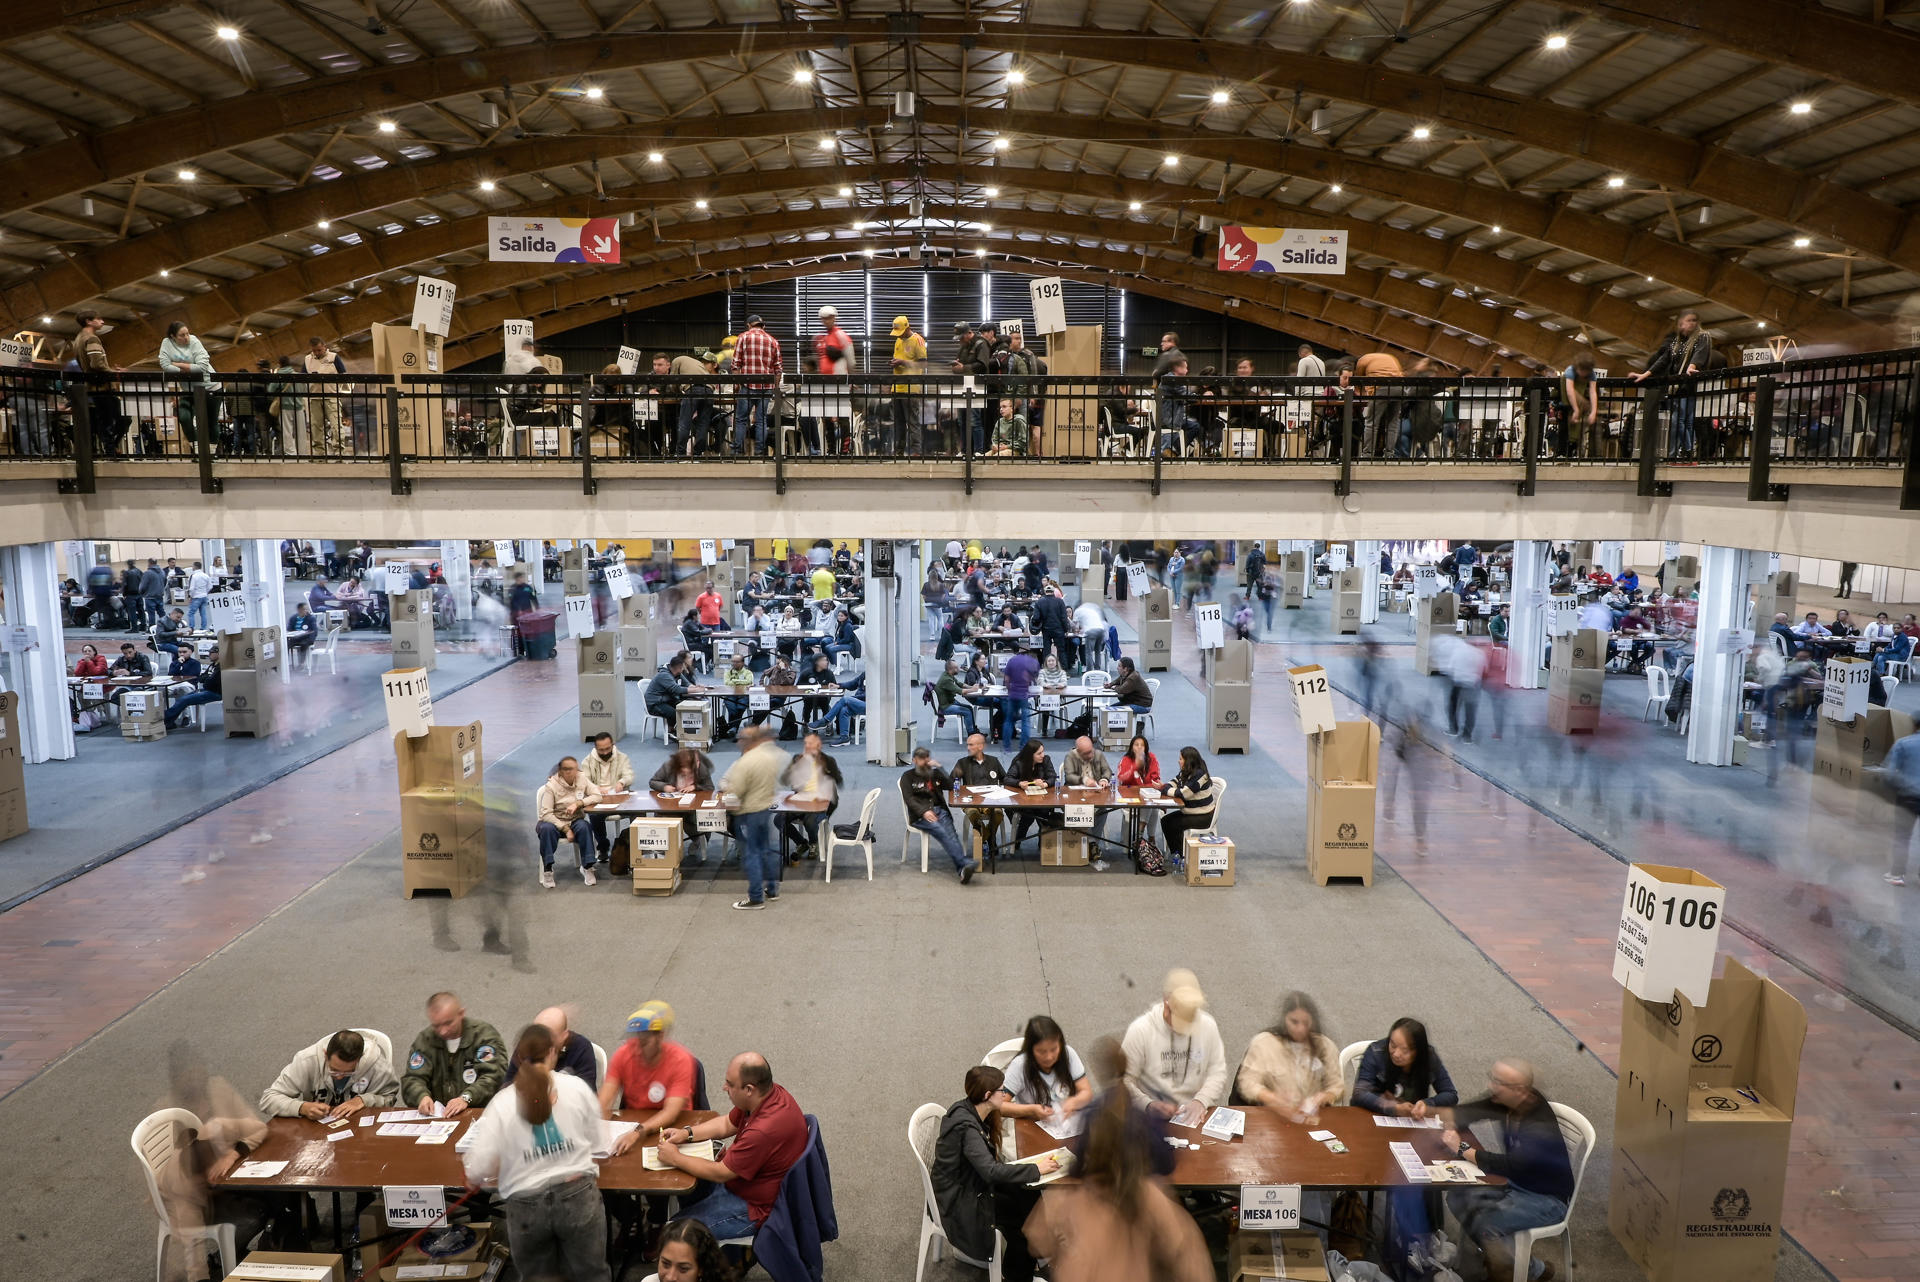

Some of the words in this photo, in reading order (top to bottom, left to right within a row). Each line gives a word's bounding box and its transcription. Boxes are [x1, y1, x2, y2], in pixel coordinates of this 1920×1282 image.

[499, 235, 556, 252] Salida
[1282, 248, 1338, 265] Salida
[420, 282, 442, 299] 191
[1035, 282, 1060, 299] 192
[506, 324, 523, 336] 197
[1002, 324, 1021, 335] 198
[1, 343, 17, 355] 202
[20, 346, 32, 356] 202
[620, 349, 633, 361] 203
[1744, 353, 1754, 362] 205
[1755, 351, 1769, 361] 205
[496, 542, 508, 551] 128
[387, 565, 401, 574] 122
[607, 568, 623, 579] 123
[1131, 566, 1145, 577] 124
[1421, 569, 1436, 578] 125
[210, 597, 229, 609] 116
[231, 595, 243, 607] 116
[566, 600, 586, 612] 117
[1558, 600, 1576, 610] 119
[1201, 609, 1221, 621] 118
[1827, 666, 1845, 683] 113
[1849, 669, 1869, 683] 113
[387, 680, 412, 697] 111
[416, 678, 428, 694] 111
[1298, 677, 1327, 695] 112
[1630, 881, 1656, 921] 106
[1662, 897, 1718, 930] 106
[389, 1208, 418, 1218] MESA
[421, 1208, 443, 1218] 105
[1243, 1209, 1272, 1220] MESA
[1275, 1208, 1297, 1219] 106
[1686, 1222, 1772, 1232] REGISTRADURÍA
